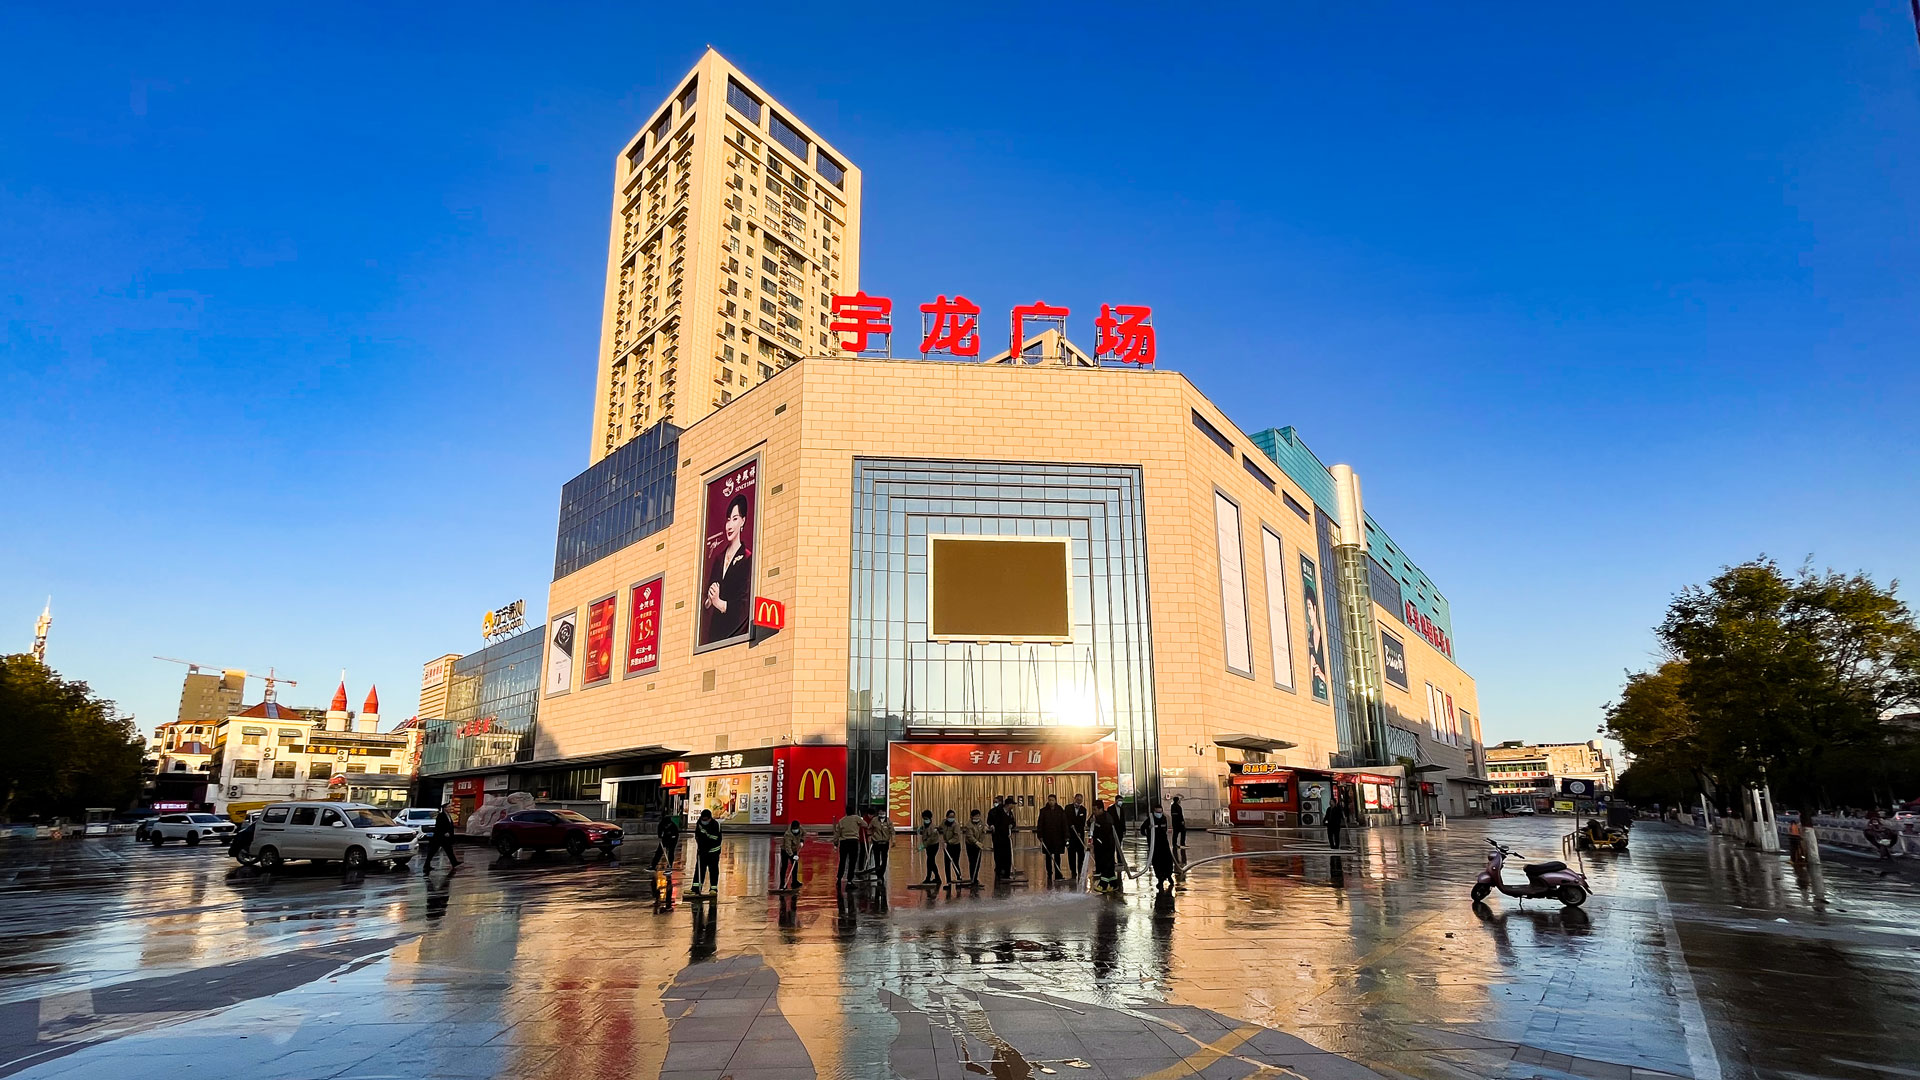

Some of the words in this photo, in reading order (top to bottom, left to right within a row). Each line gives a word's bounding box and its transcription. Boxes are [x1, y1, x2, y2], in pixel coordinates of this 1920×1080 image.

[830, 291, 1157, 364] 宇龙广场
[710, 753, 743, 769] 麦当劳
[969, 749, 1042, 765] 宇龙广场
